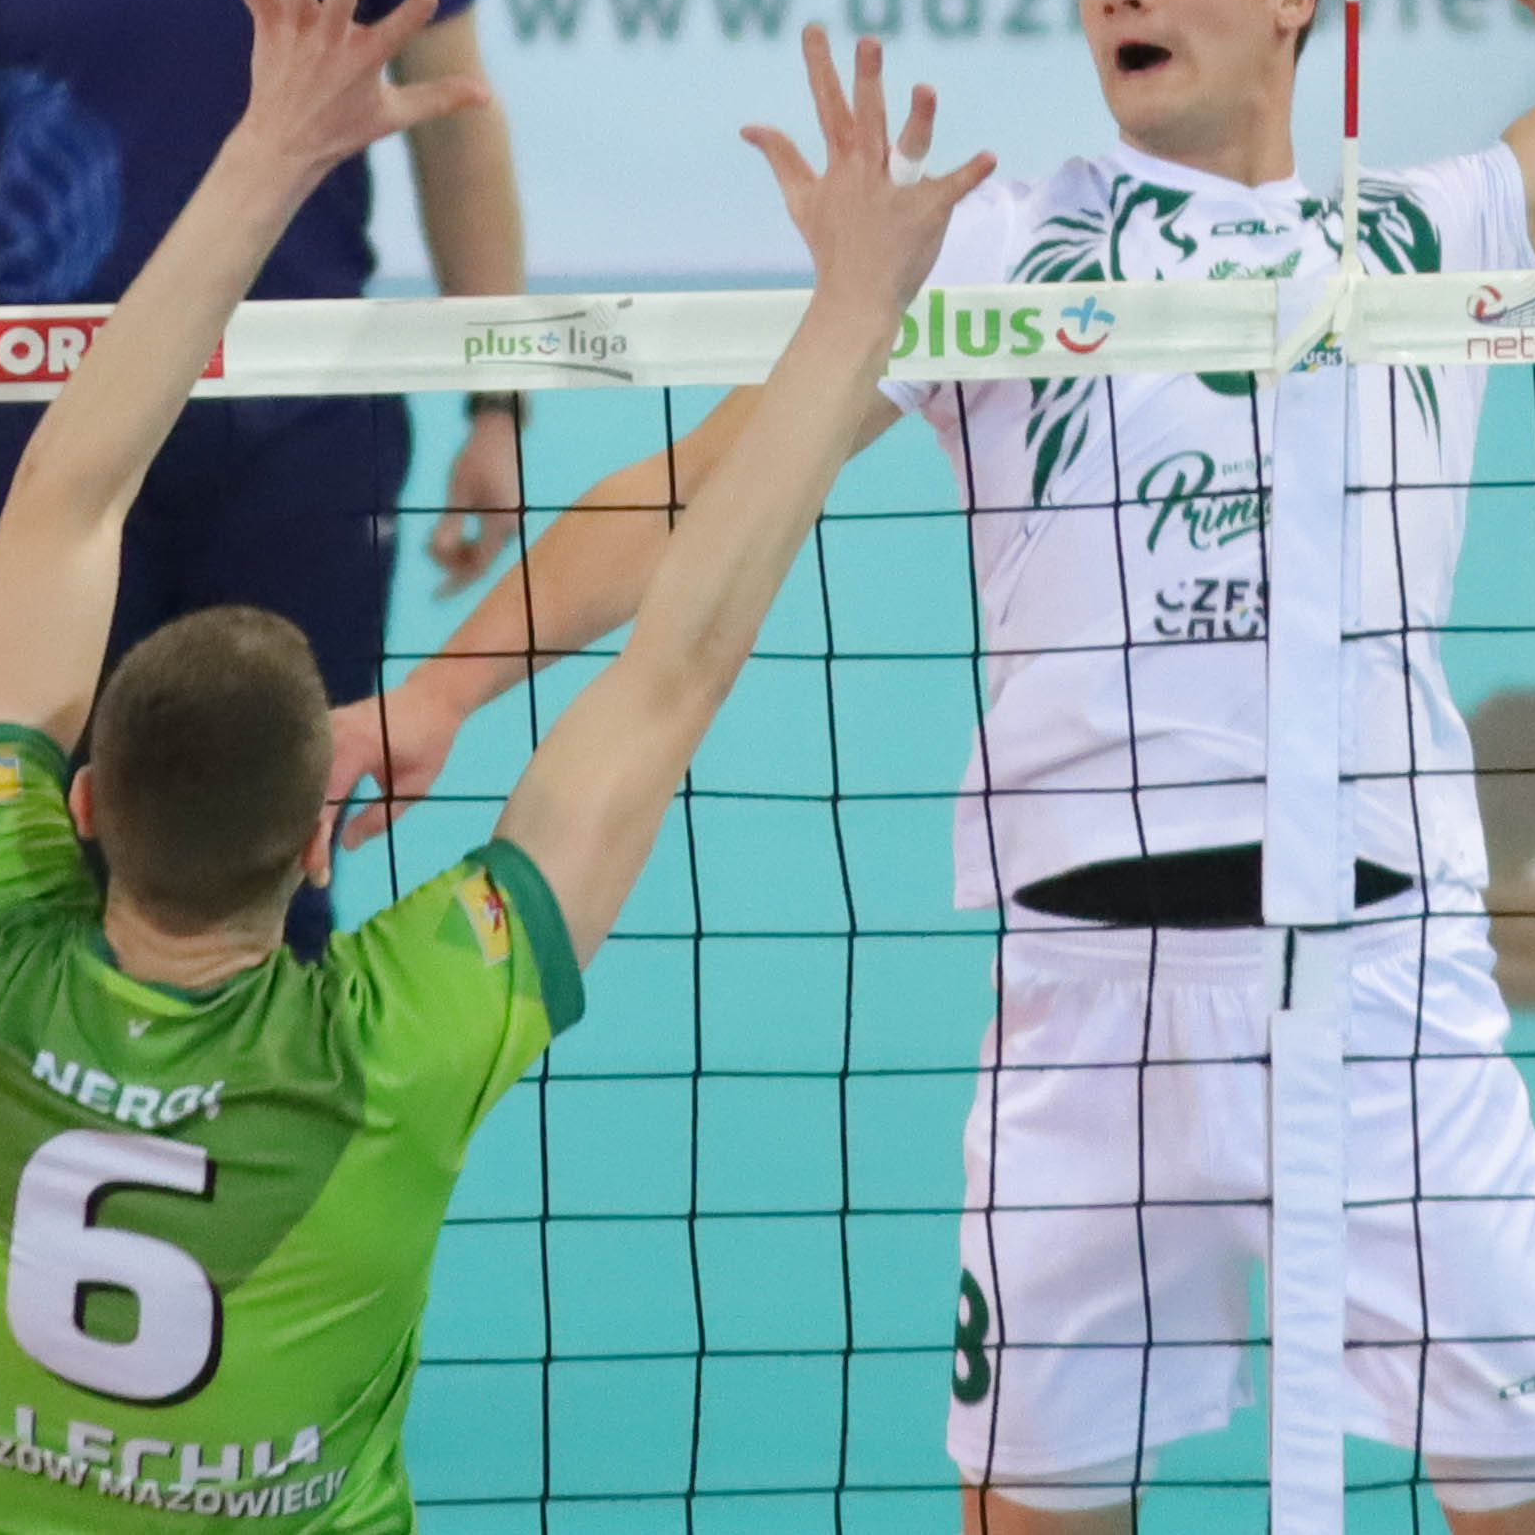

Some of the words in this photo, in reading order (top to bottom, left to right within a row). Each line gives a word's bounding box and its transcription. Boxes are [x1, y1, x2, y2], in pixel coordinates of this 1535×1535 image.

[464, 327, 533, 364] plus
[568, 325, 628, 361] liga
[6, 1127, 223, 1407] 6
